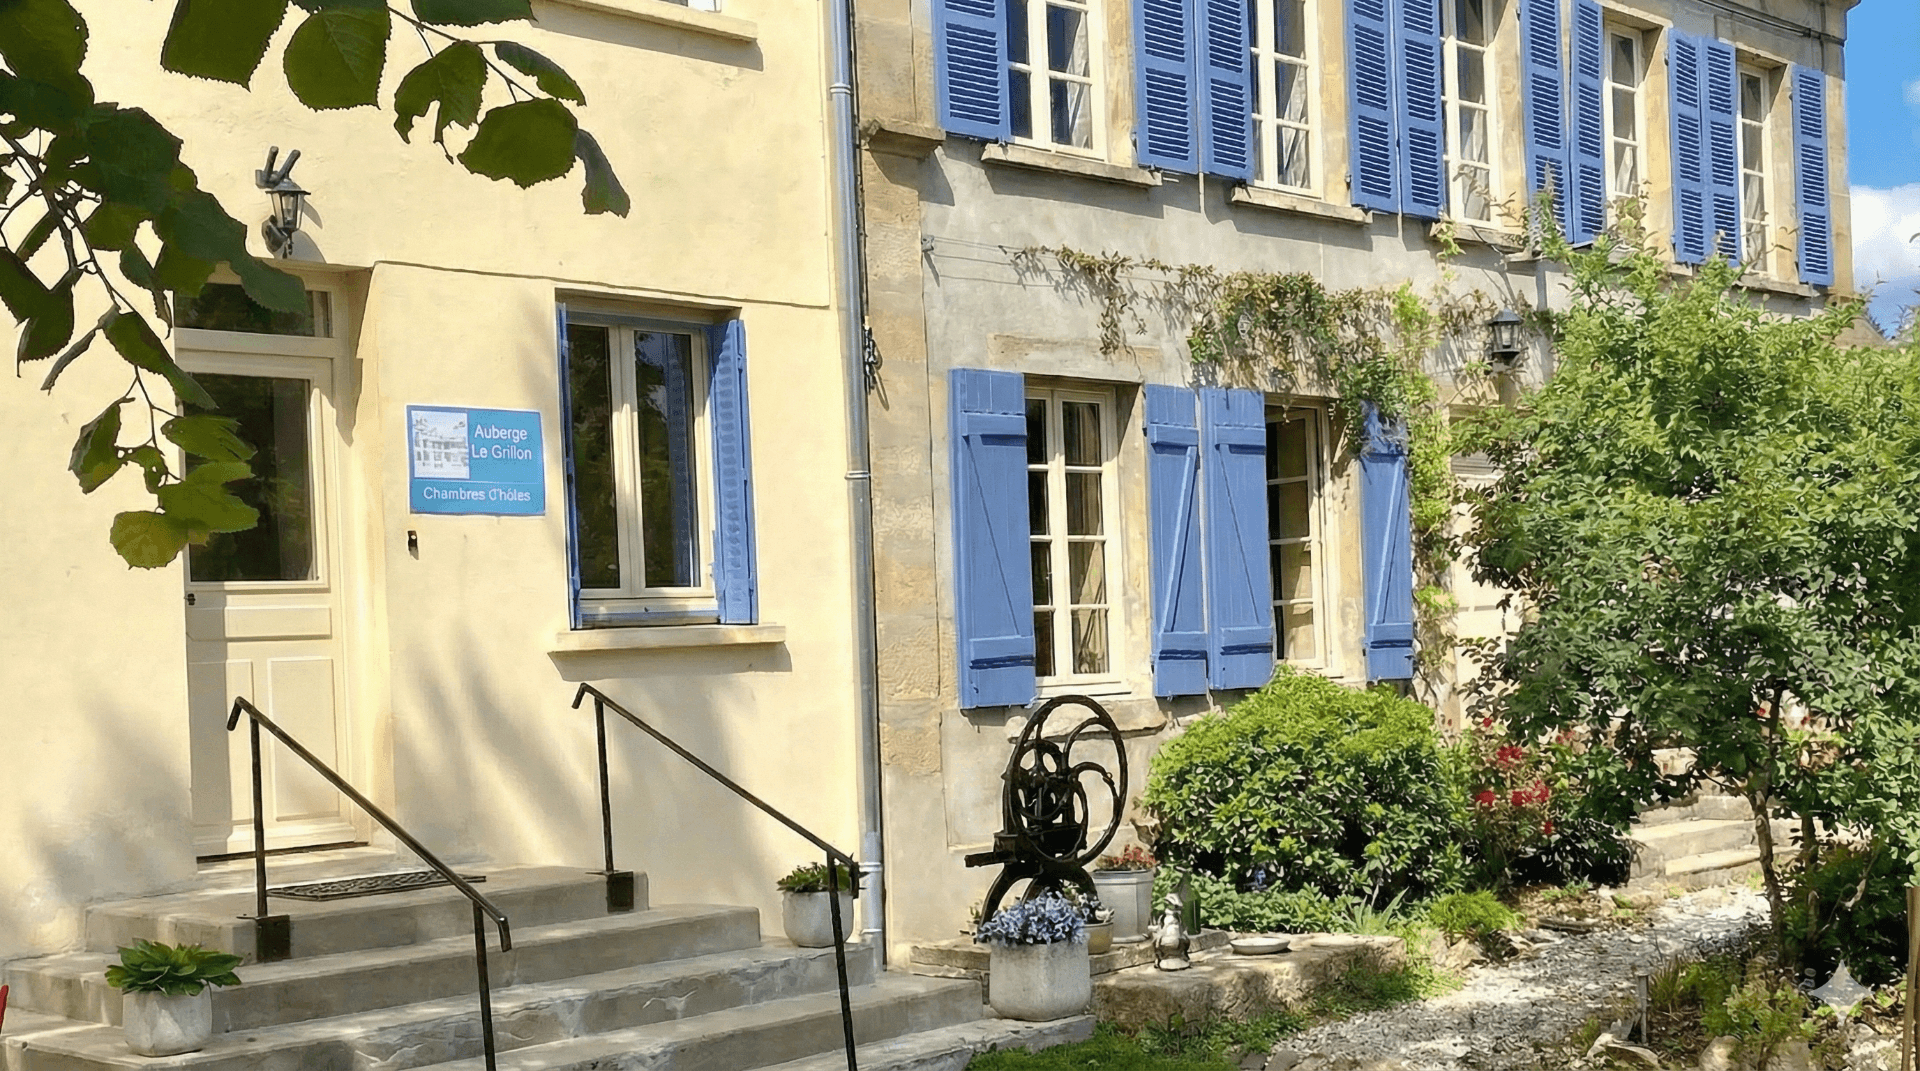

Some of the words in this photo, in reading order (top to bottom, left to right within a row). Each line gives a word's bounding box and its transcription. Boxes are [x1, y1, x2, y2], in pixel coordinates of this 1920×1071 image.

[474, 424, 528, 443] Auberge
[471, 444, 488, 458] Le
[491, 445, 532, 460] Grillon
[423, 487, 486, 500] Chambres
